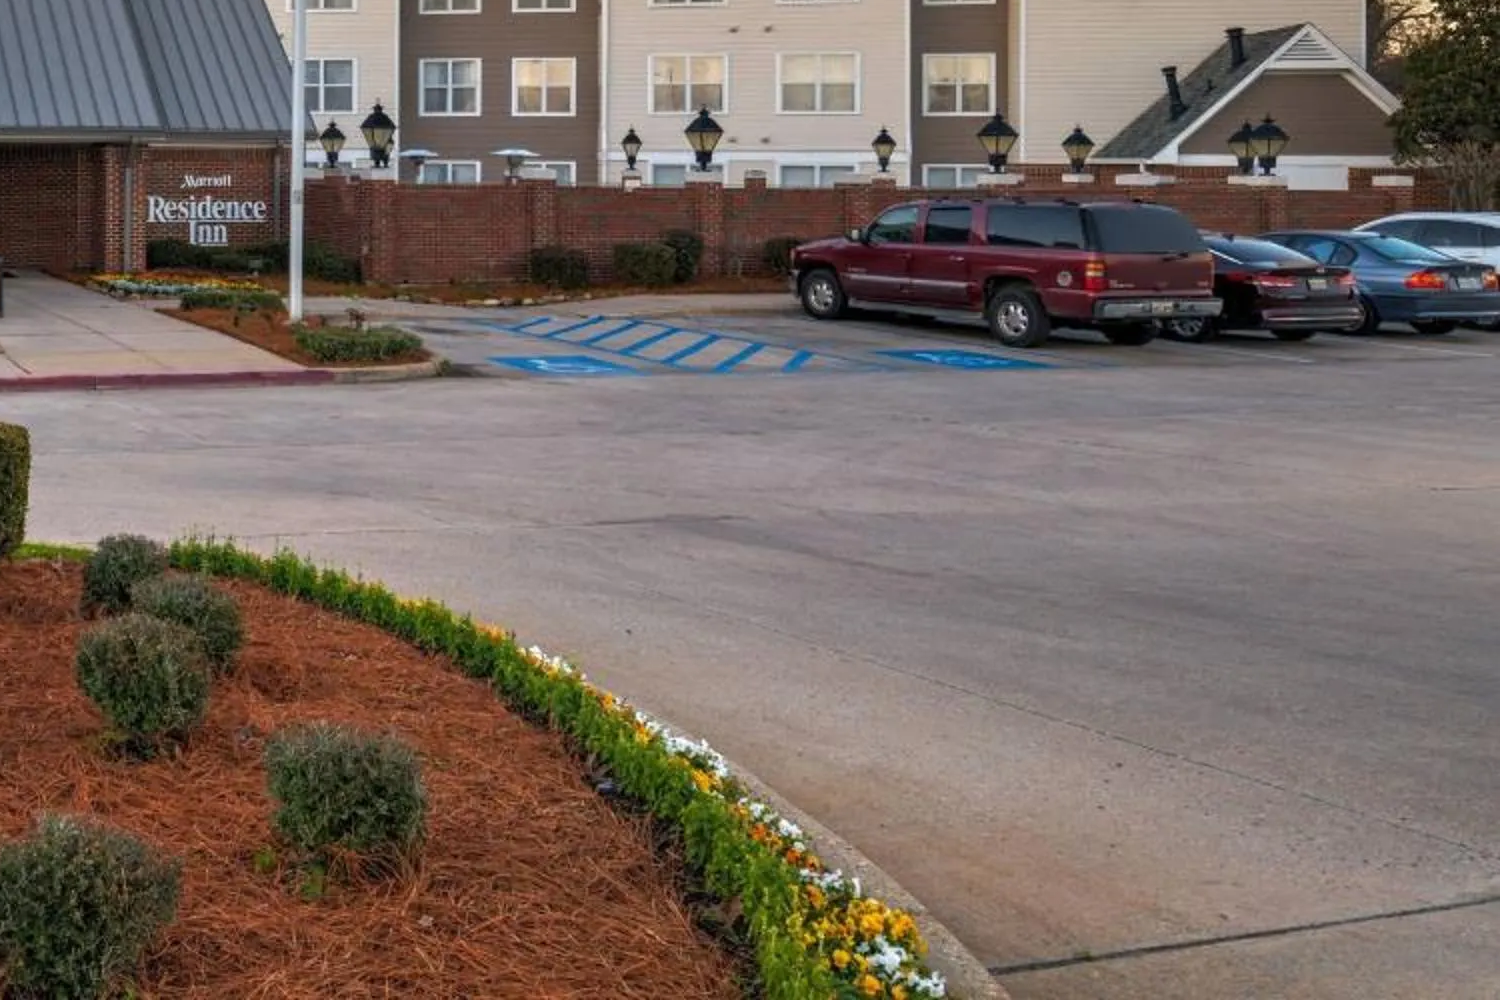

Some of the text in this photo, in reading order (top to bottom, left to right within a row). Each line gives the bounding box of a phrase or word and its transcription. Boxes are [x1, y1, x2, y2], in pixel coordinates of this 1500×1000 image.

[180, 174, 232, 189] Marriott
[147, 195, 268, 223] Residence
[189, 220, 229, 247] Inn
